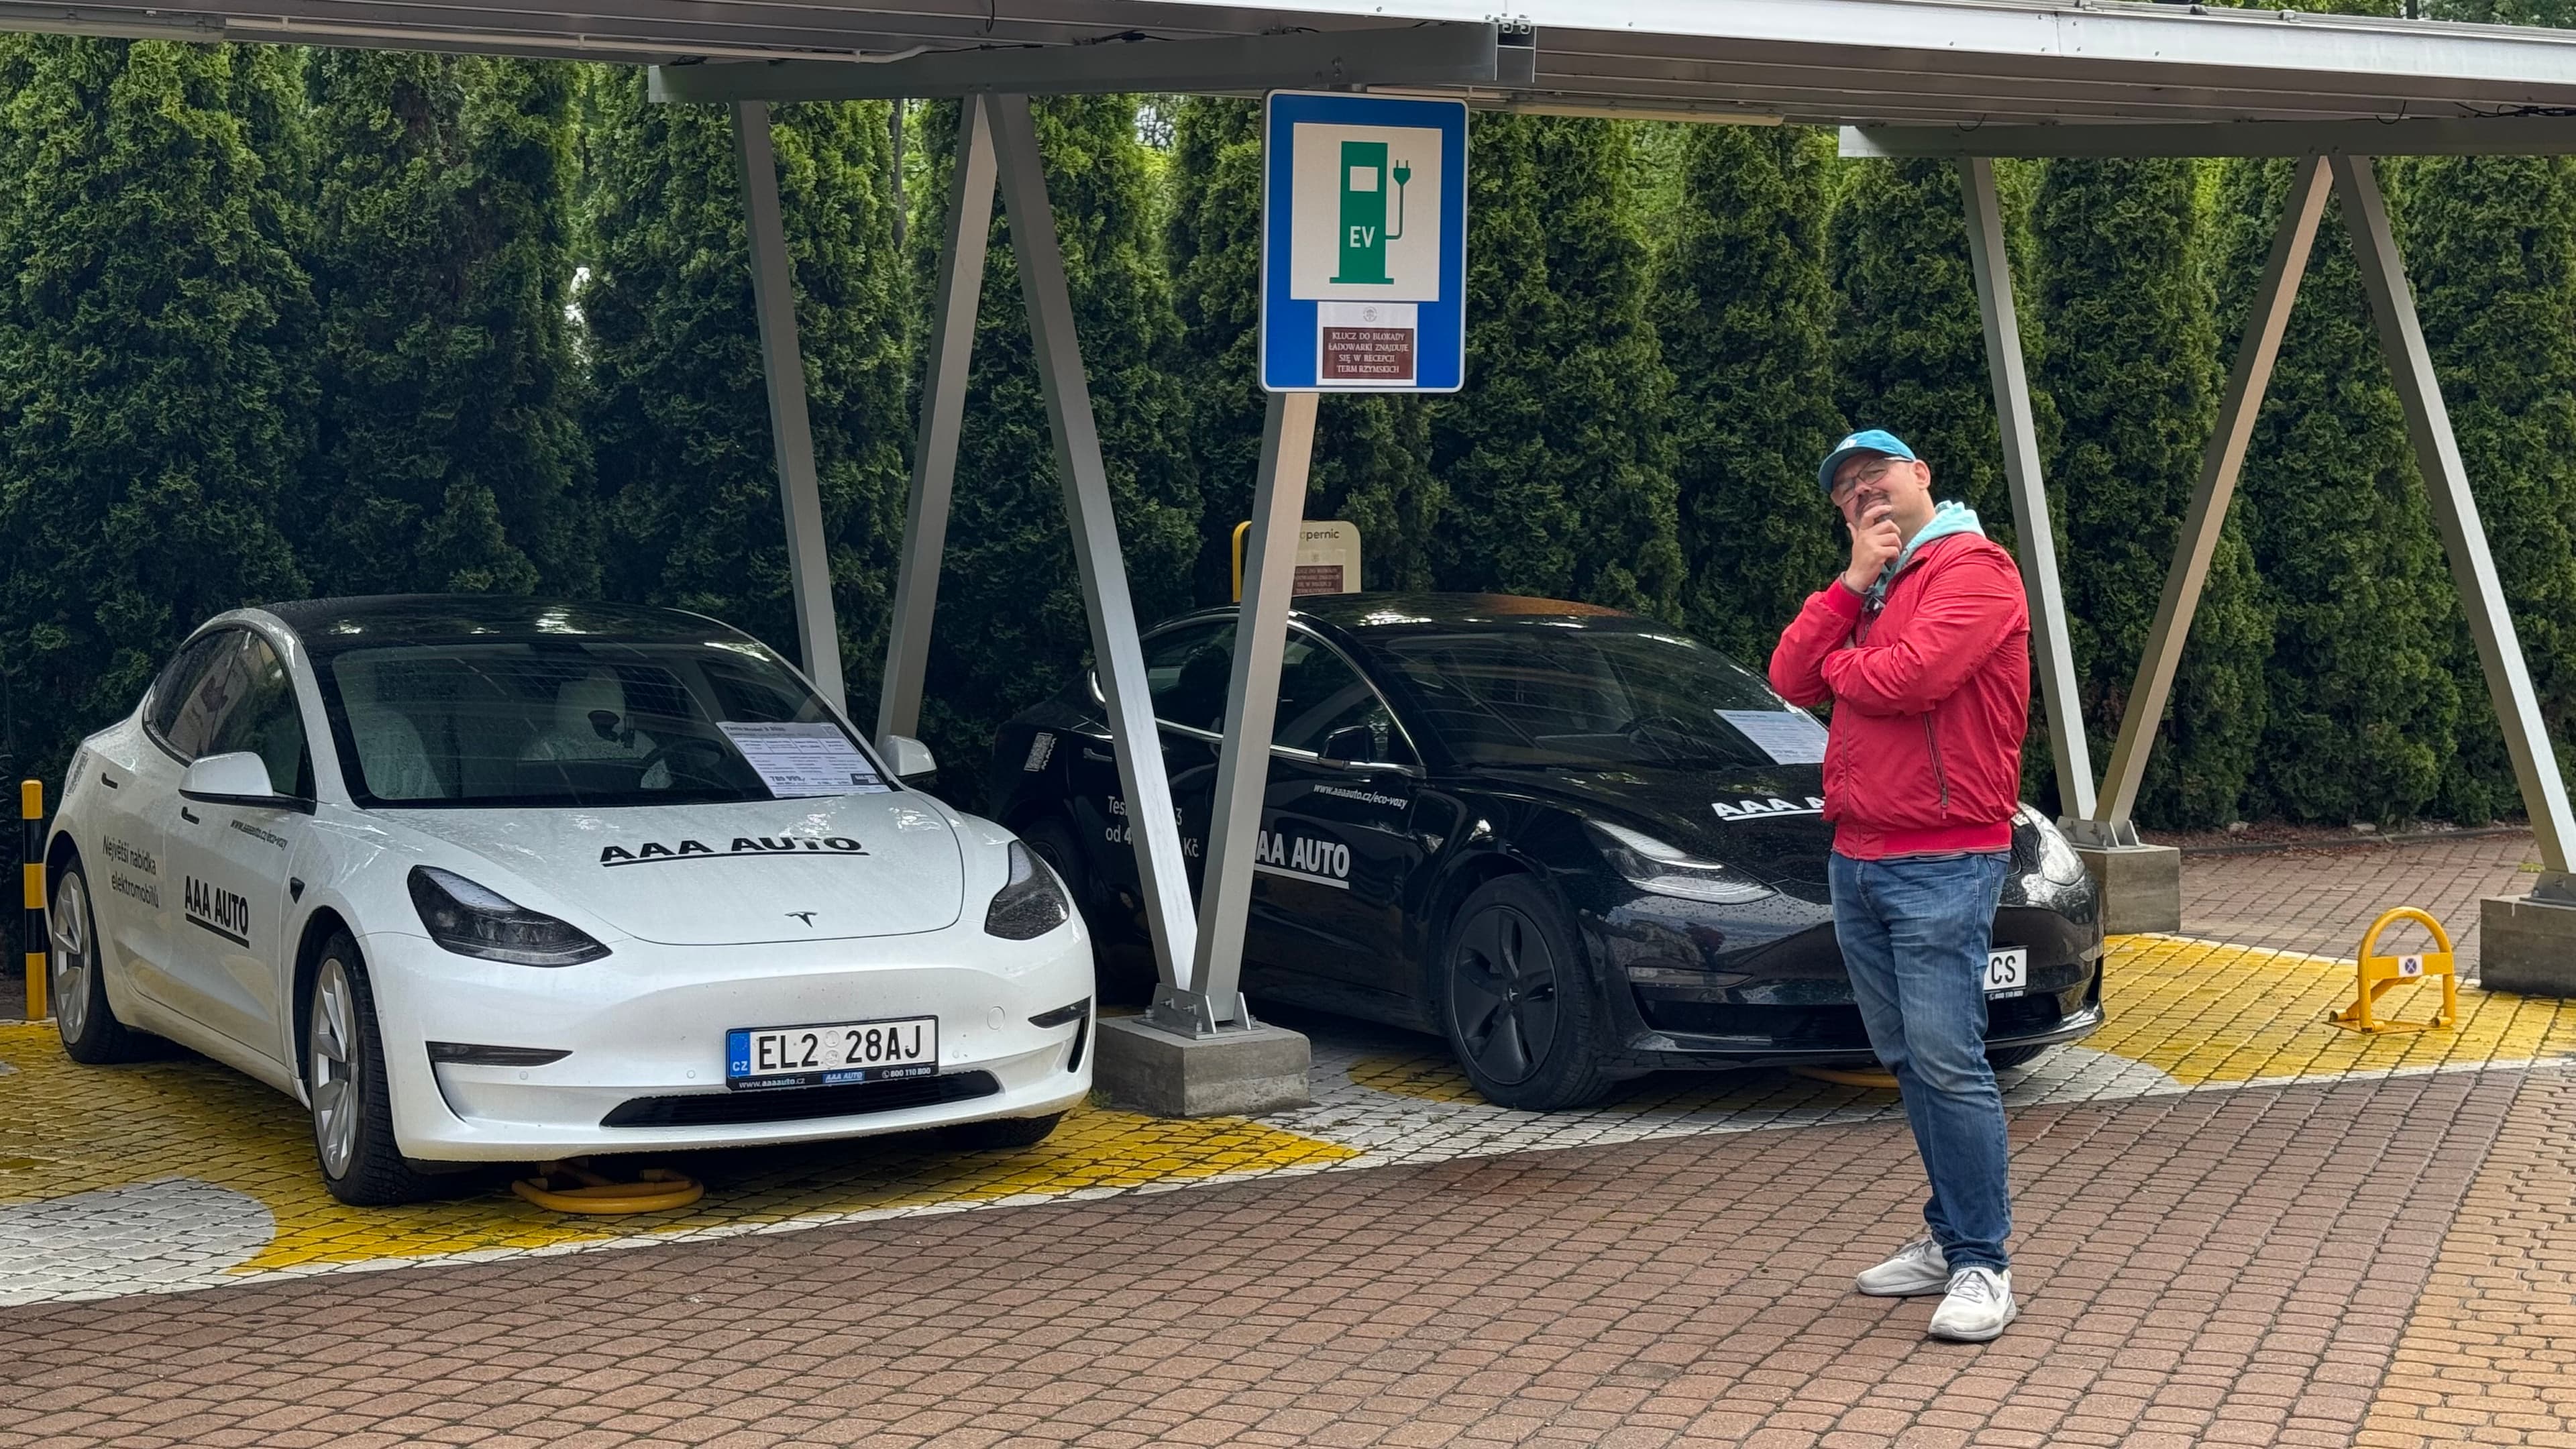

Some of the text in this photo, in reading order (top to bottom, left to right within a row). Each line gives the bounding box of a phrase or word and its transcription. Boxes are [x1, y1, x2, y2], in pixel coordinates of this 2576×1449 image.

[1350, 226, 1375, 248] EV
[1373, 333, 1405, 341] BLOKADY
[1328, 343, 1409, 352] ŁADOWARKI ZNAJDUJE
[1339, 354, 1351, 364] SIĘ
[1711, 798, 1802, 817] AAA
[1106, 824, 1121, 843] od
[600, 837, 863, 863] AAA AUTO
[1183, 837, 1199, 857] Kč
[1255, 830, 1350, 878] AA AUTO
[185, 875, 249, 936] AAA AUTO
[1991, 955, 2016, 984] CS
[759, 1025, 922, 1070] EL2 28AJ
[732, 1060, 749, 1072] CZ
[890, 1071, 905, 1079] 800
[906, 1069, 917, 1077] 110
[739, 1077, 806, 1089] www.aaaauto.cz
[824, 1072, 863, 1083] AAA AUTO
